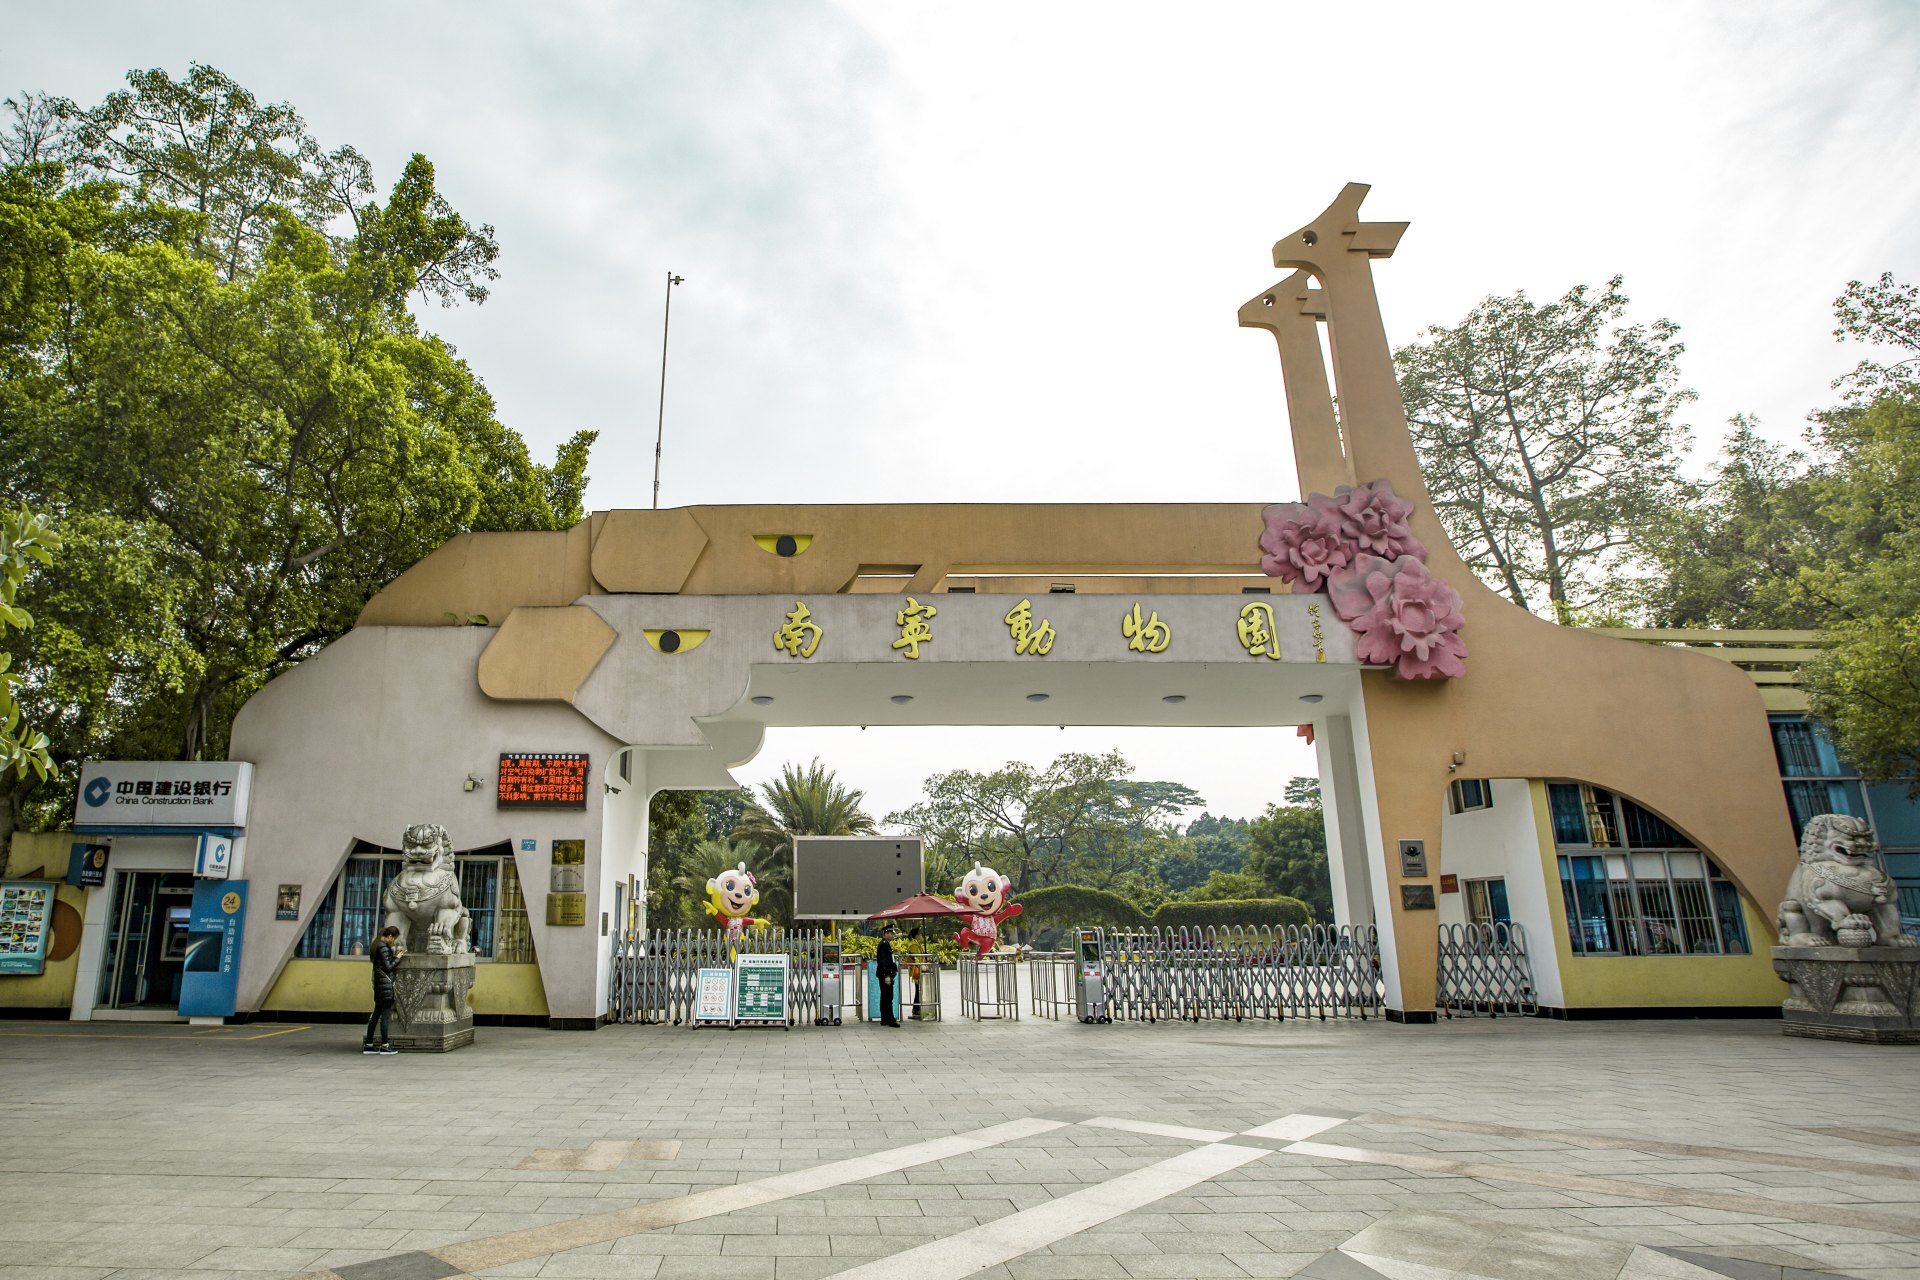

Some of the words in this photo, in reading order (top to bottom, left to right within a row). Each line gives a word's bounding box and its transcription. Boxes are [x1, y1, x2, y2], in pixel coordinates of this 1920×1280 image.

[116, 780, 232, 796] 中国建设银行
[115, 795, 139, 805] China
[142, 796, 191, 805] Construction
[193, 796, 214, 805] Bank
[223, 896, 236, 906] 24
[223, 918, 236, 973] 自助银行服务
